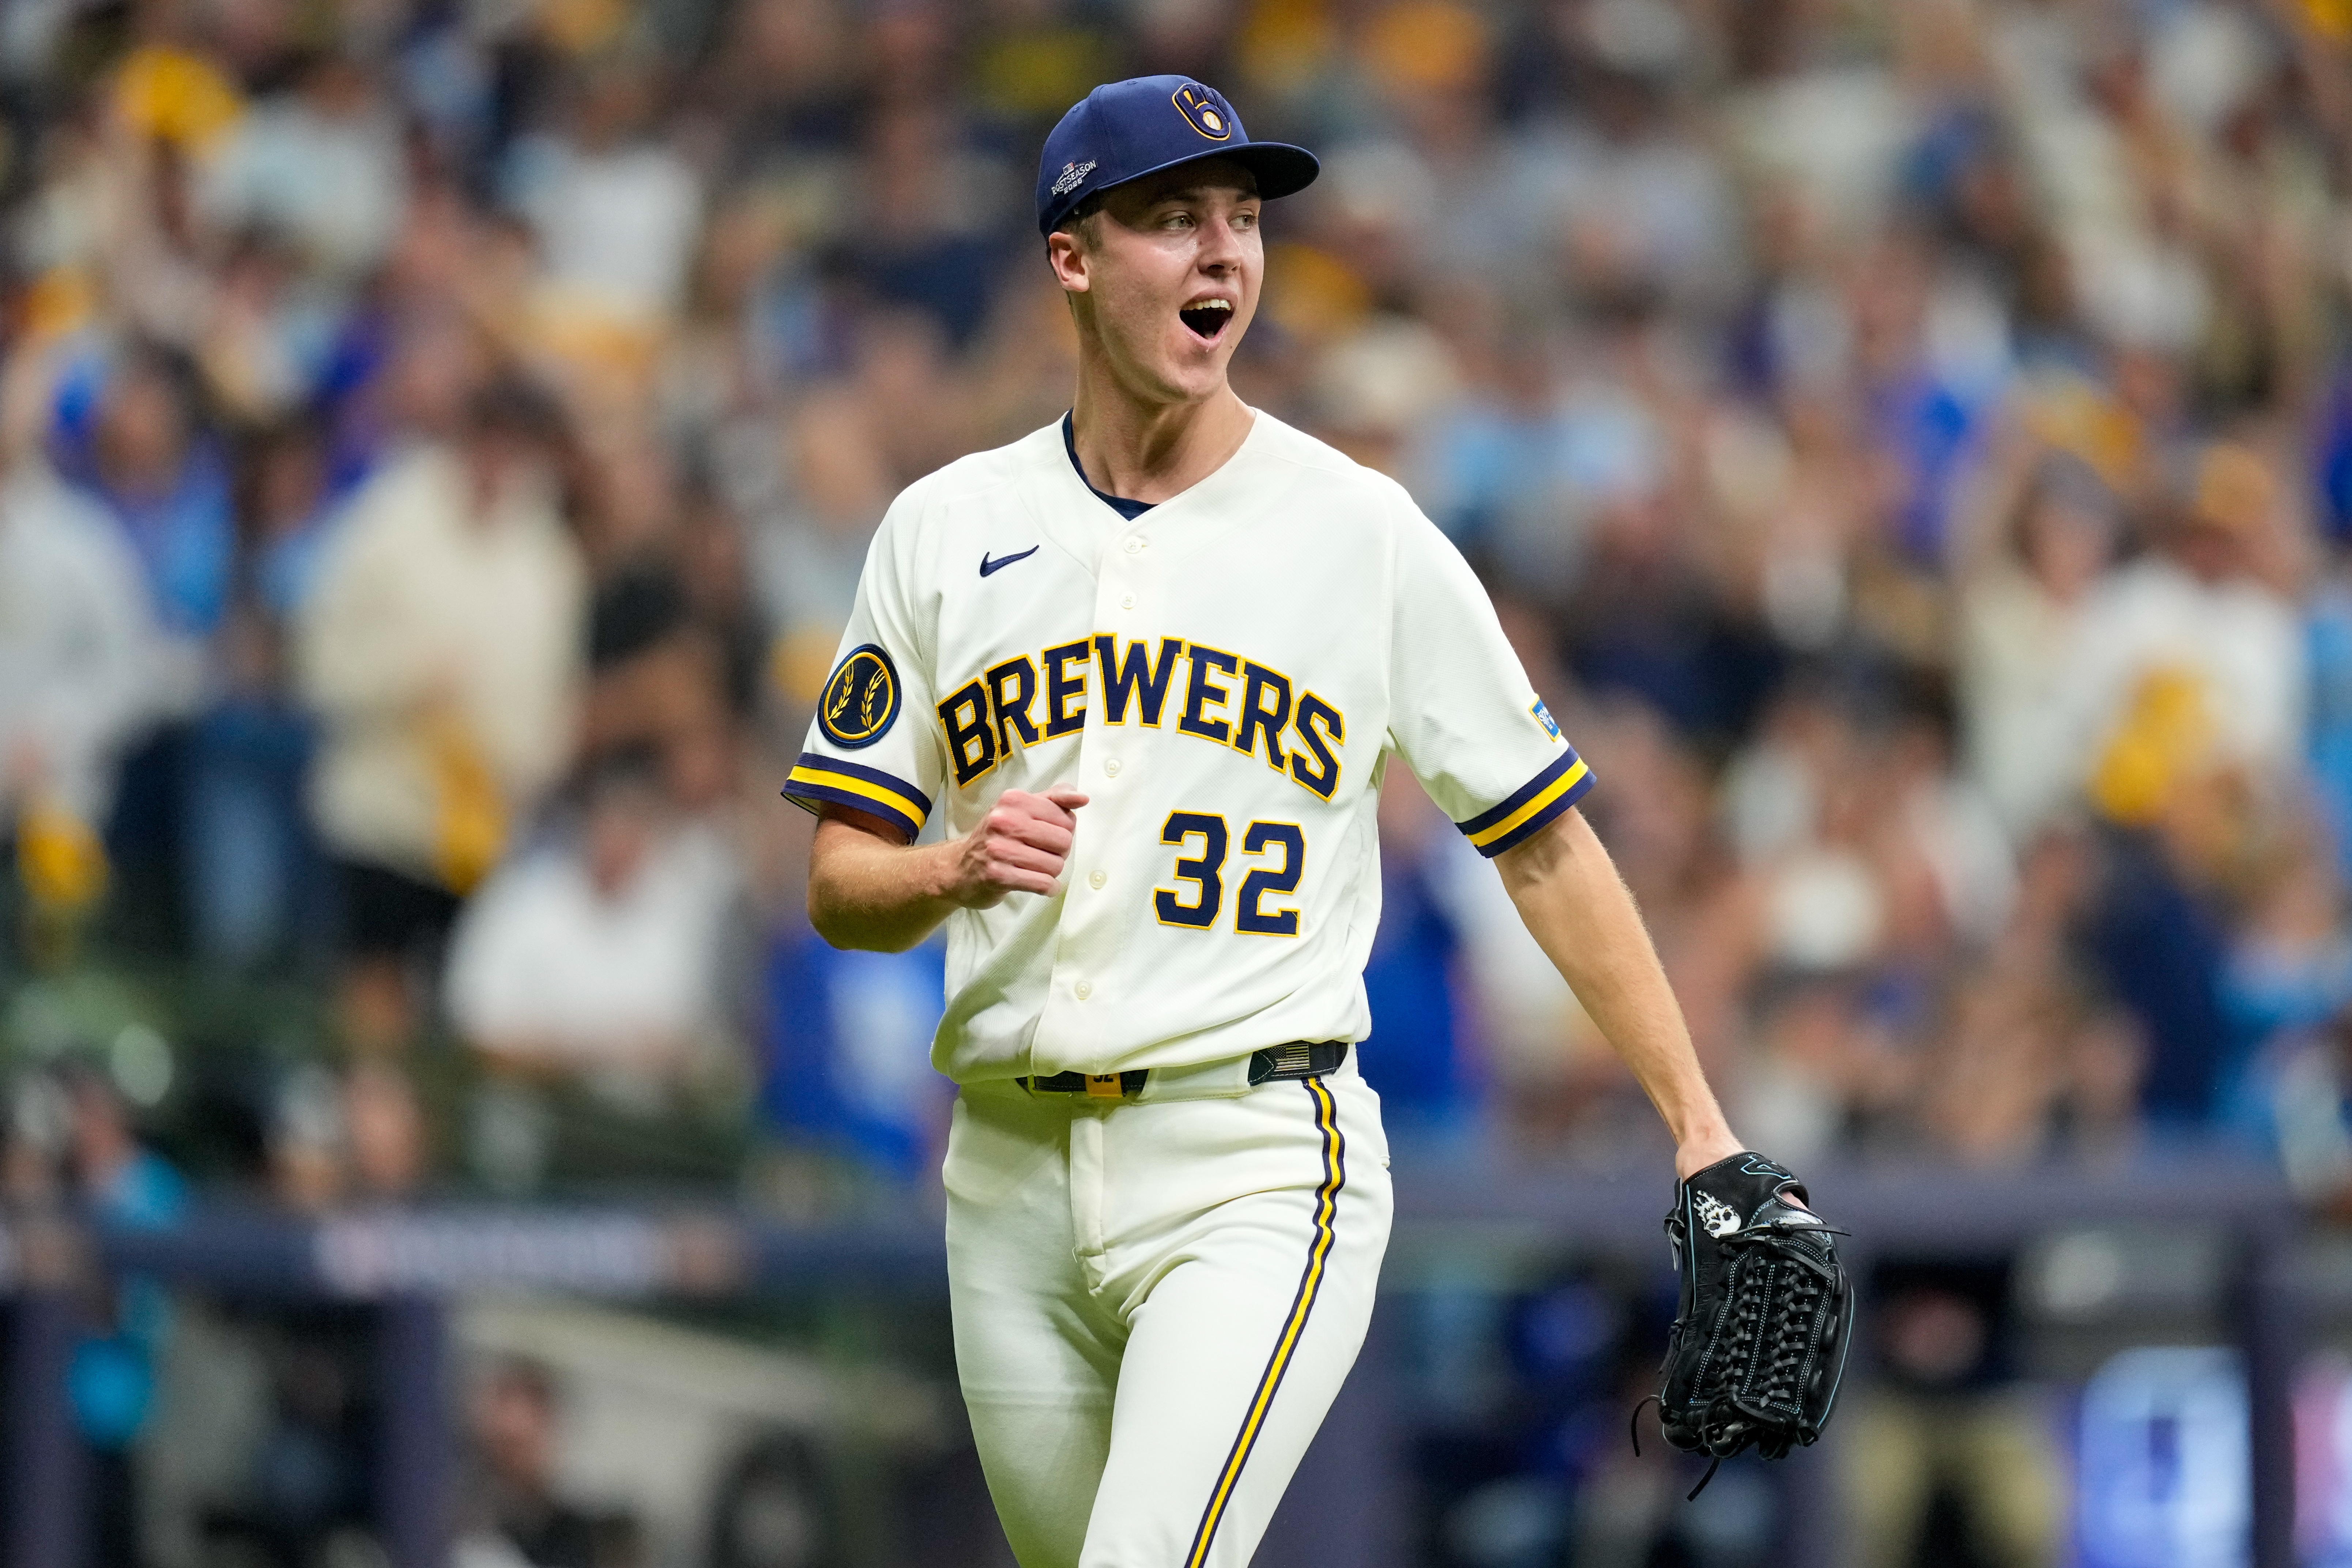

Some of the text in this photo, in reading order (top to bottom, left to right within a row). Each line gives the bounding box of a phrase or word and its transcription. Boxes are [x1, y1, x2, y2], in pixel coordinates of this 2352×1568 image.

[1051, 160, 1096, 196] POSTSEASON
[1064, 178, 1082, 195] 2025
[935, 632, 1345, 803] BREWERS
[1152, 810, 1306, 938] 32
